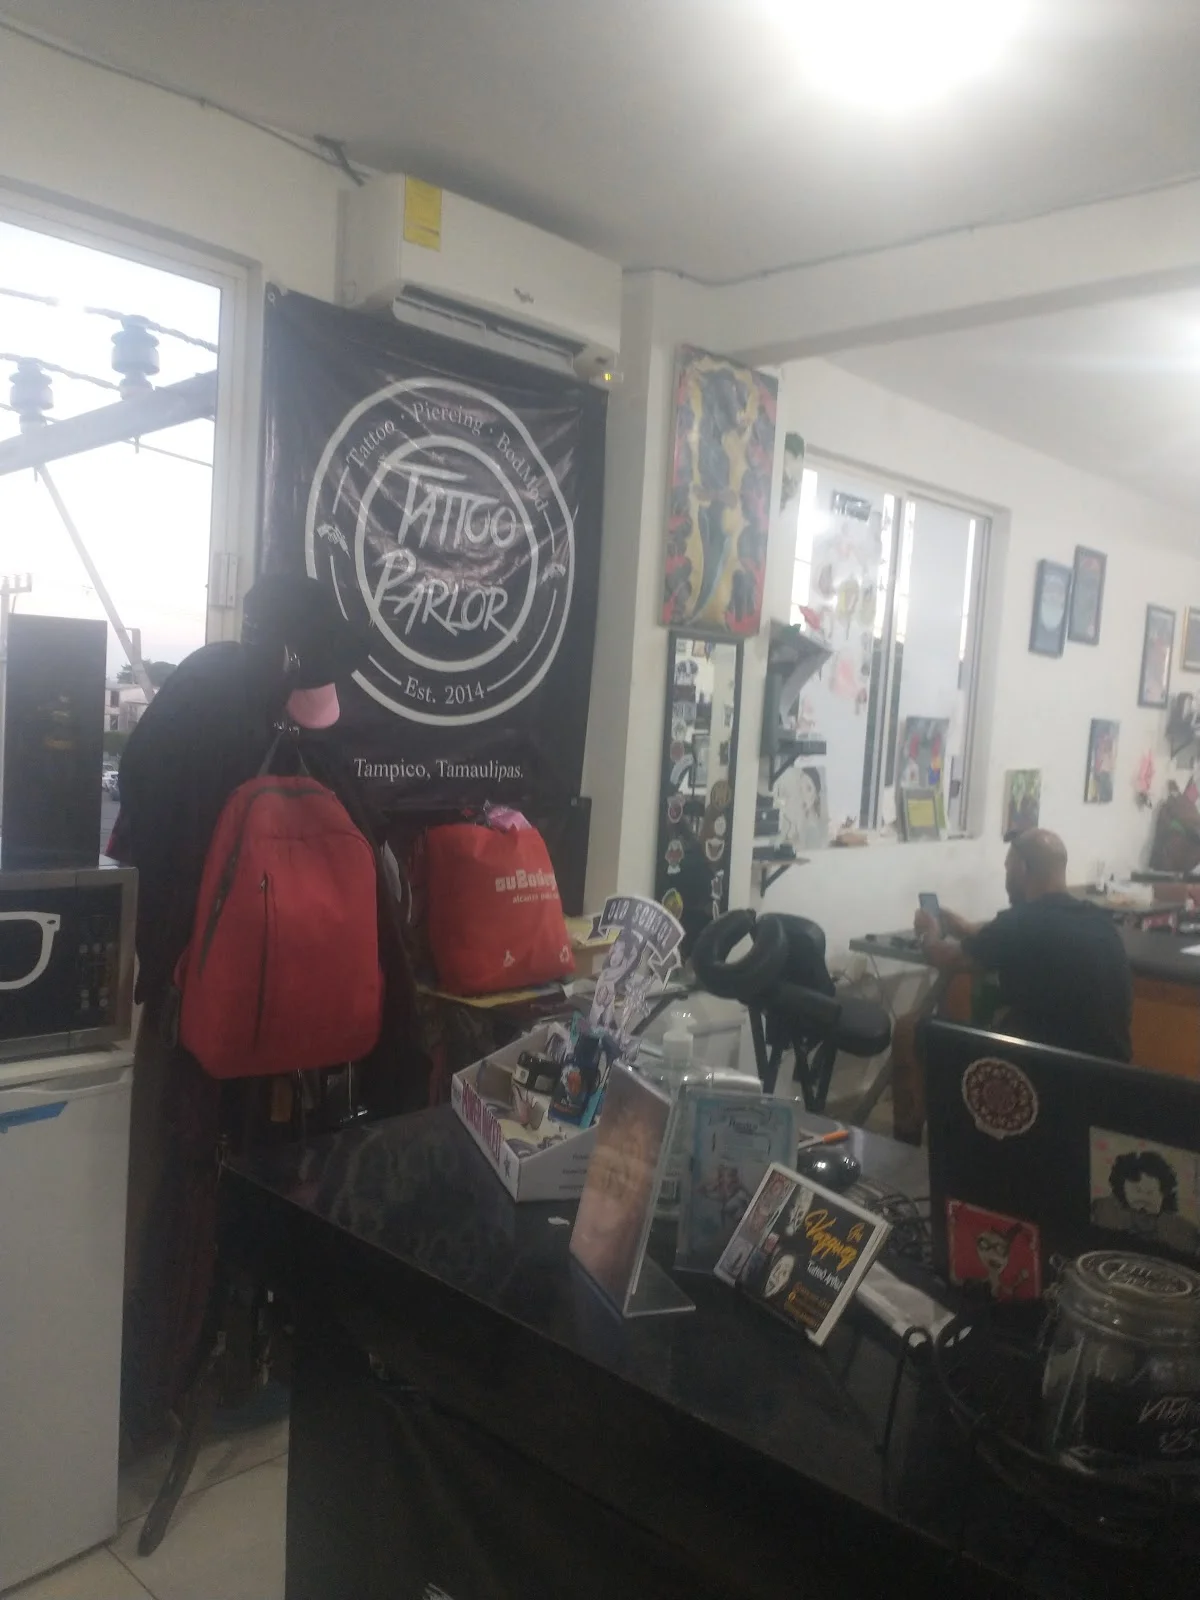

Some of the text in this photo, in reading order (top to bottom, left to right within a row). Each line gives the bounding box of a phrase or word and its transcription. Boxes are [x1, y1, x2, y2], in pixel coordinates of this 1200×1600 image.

[346, 419, 395, 467] Tattoo
[413, 402, 483, 436] Piercing
[404, 676, 485, 704] Est. 2014
[354, 758, 524, 782] Tampico, Tamaulipas.
